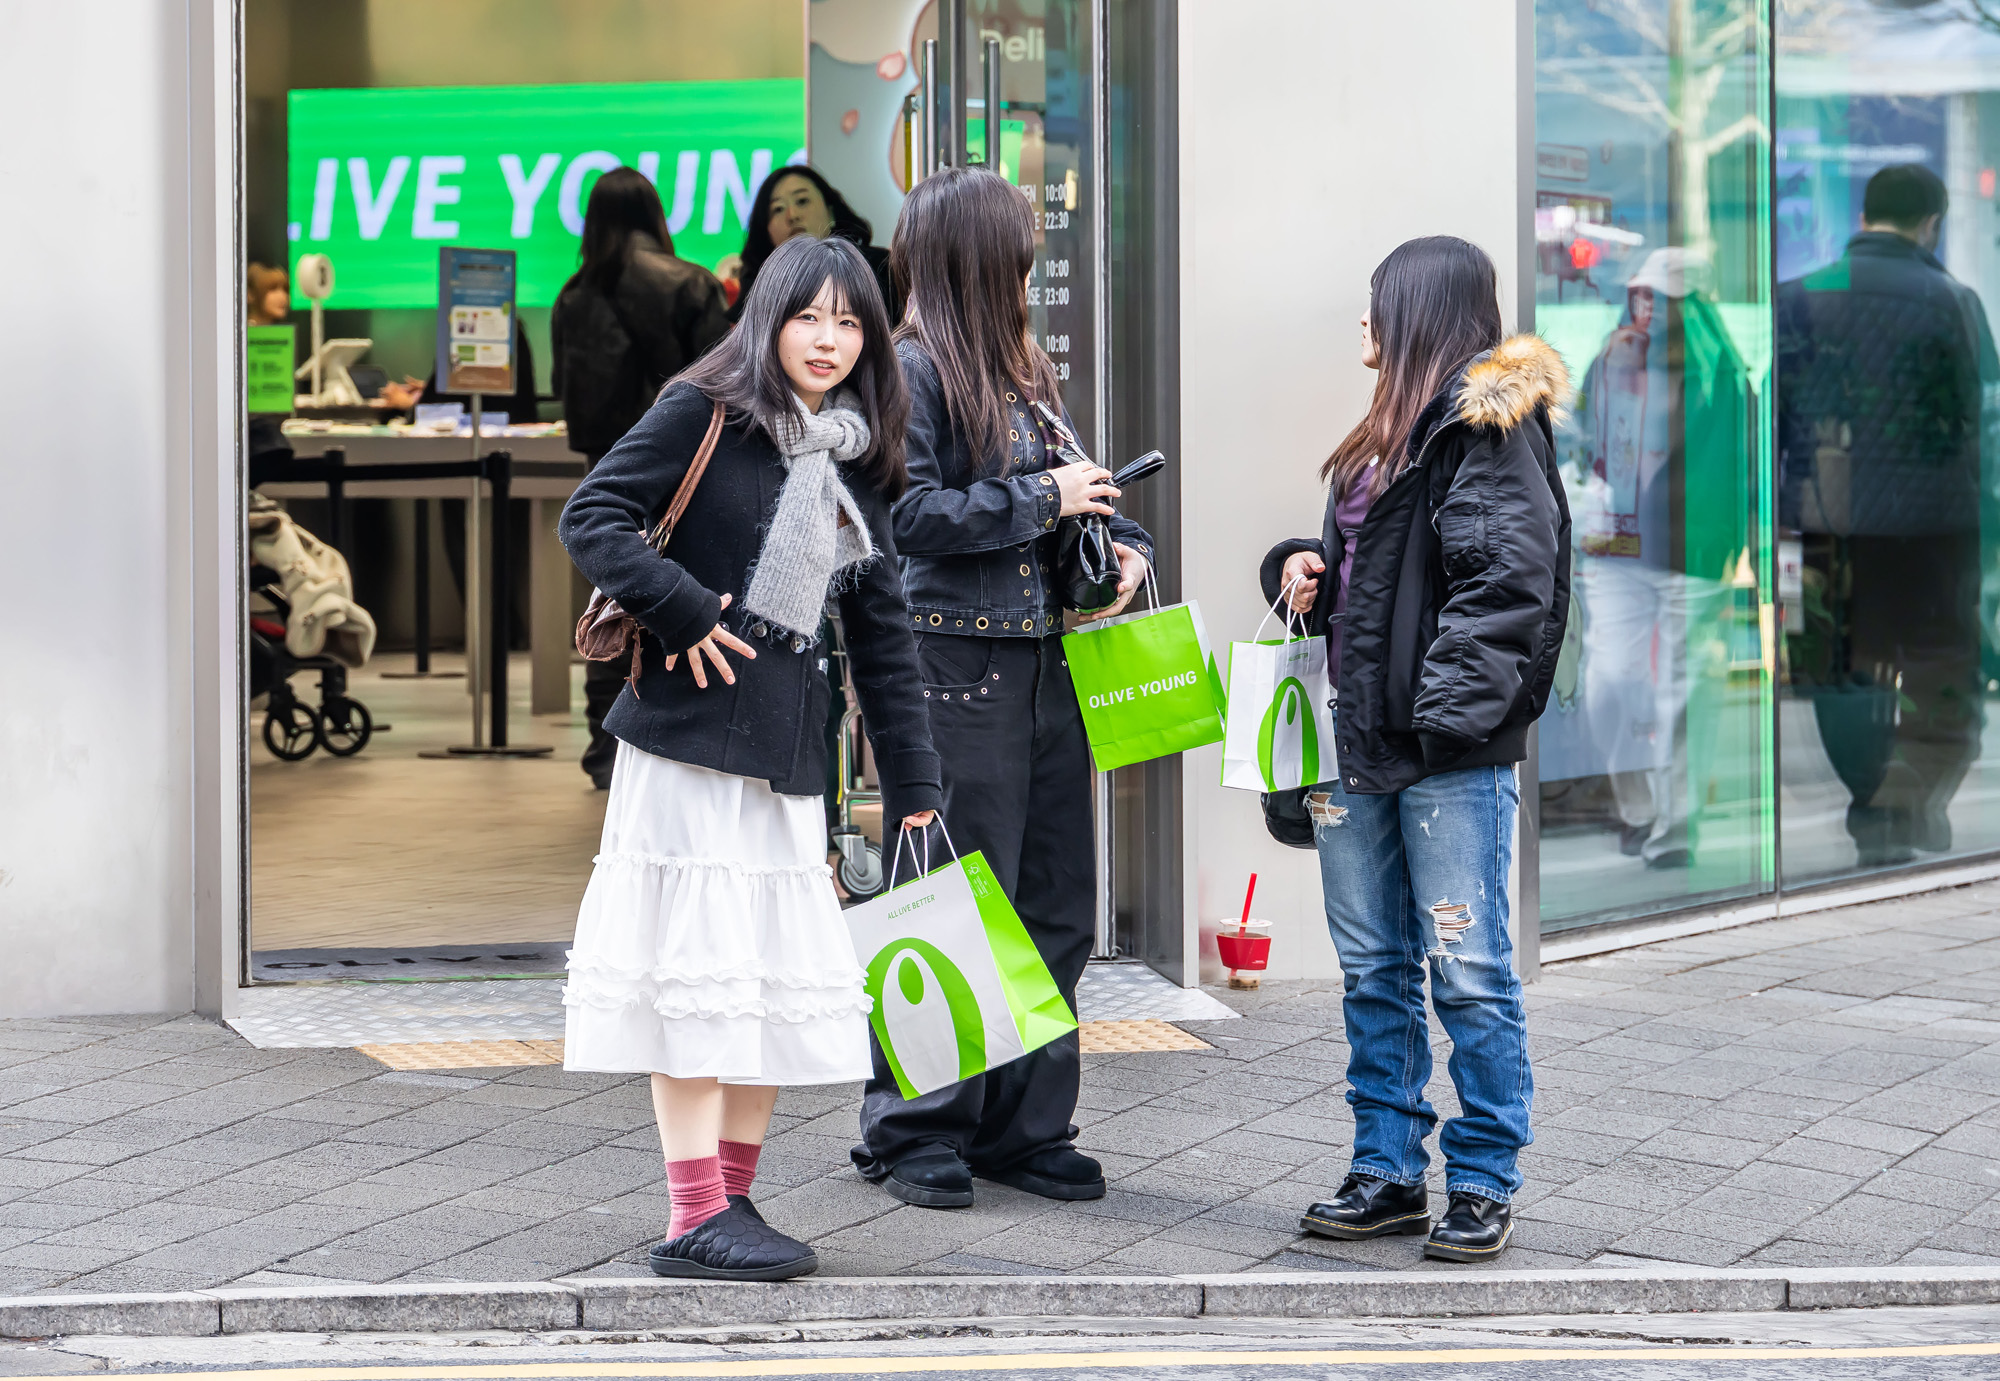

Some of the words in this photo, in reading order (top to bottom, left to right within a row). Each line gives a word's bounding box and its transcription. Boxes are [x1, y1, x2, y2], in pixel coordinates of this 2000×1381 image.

[288, 155, 467, 241] IVE
[498, 148, 807, 238] YOUN
[1045, 184, 1068, 202] 10:00
[1044, 211, 1070, 230] 22:30
[1045, 259, 1070, 278] 10:00
[1044, 286, 1070, 306] 23:00
[1045, 334, 1070, 353] 10:00
[1052, 362, 1071, 381] :30
[1089, 686, 1135, 709] OLIVE
[1138, 670, 1197, 697] YOUNG
[887, 910, 899, 920] ALL
[898, 903, 912, 916] LIVE
[911, 893, 936, 910] BETTER
